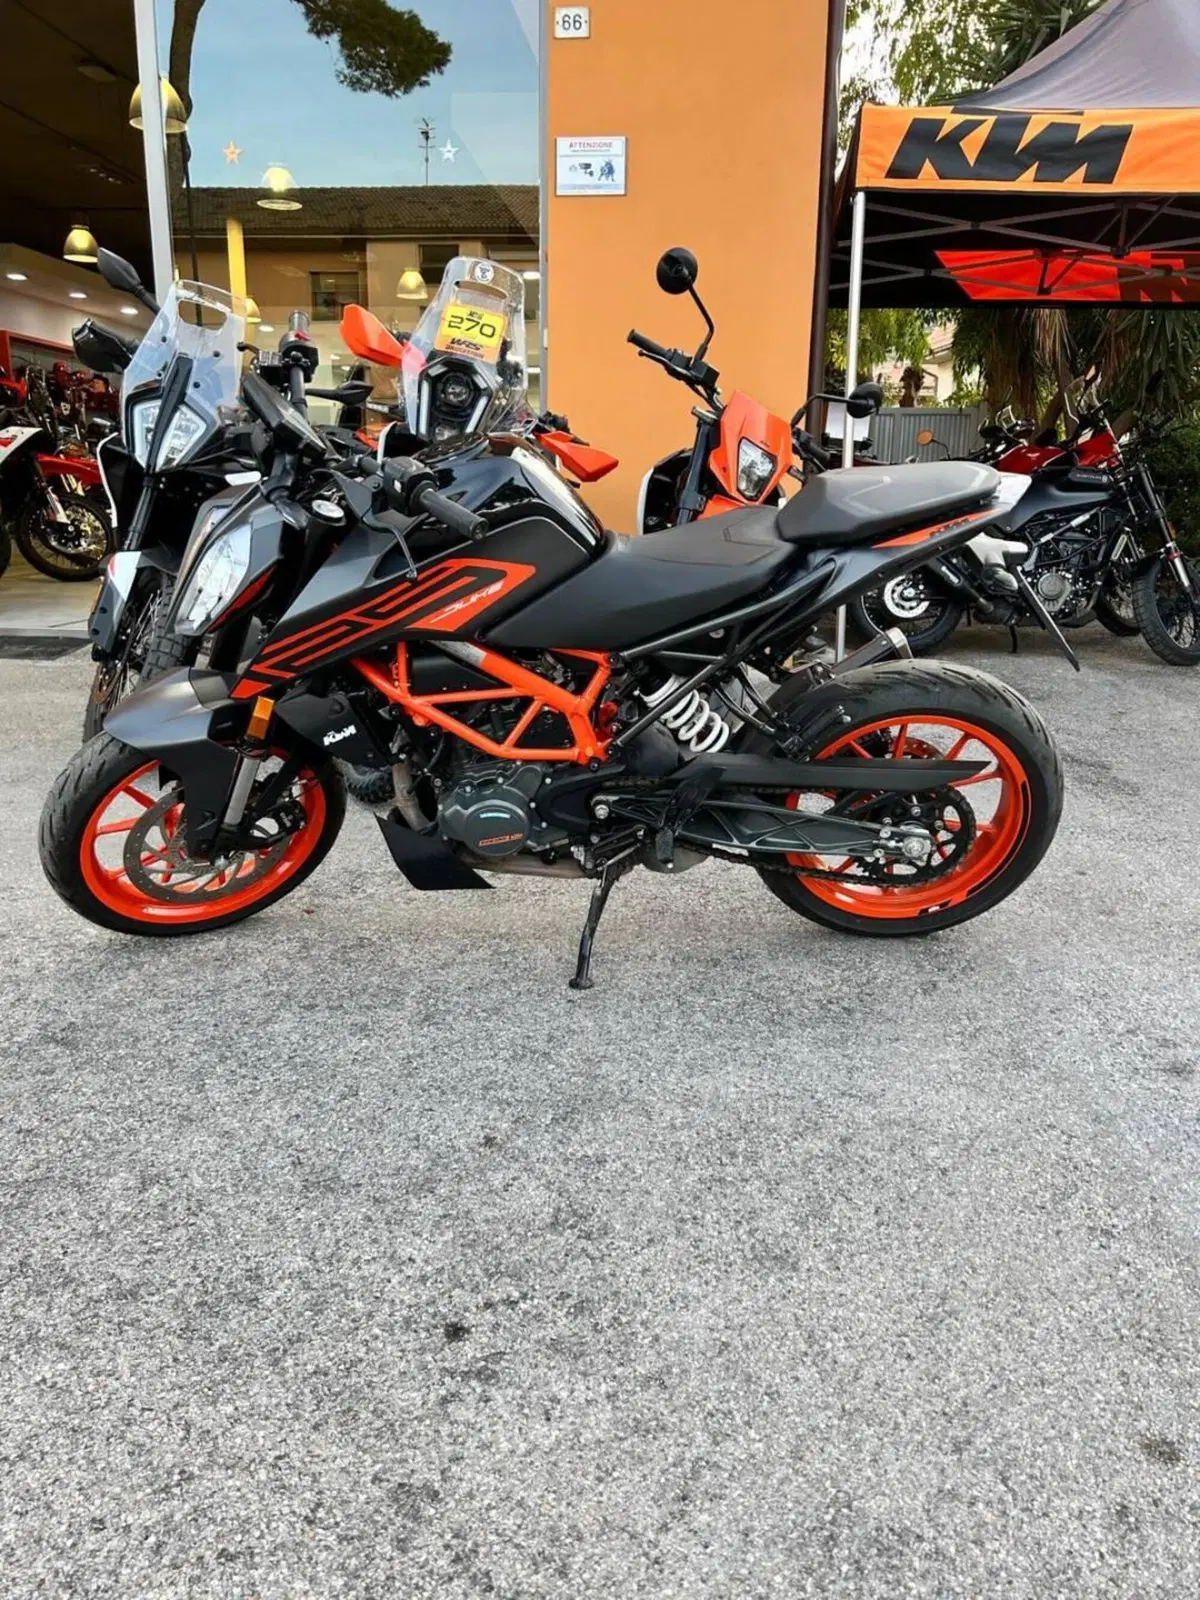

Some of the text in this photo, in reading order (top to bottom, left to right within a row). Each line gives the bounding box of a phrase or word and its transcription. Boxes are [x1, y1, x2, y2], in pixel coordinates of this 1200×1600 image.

[562, 14, 582, 31] 66
[569, 141, 613, 149] ATTENZIONE
[885, 107, 1133, 184] KTM
[447, 314, 496, 339] 270
[323, 724, 356, 746] KTM
